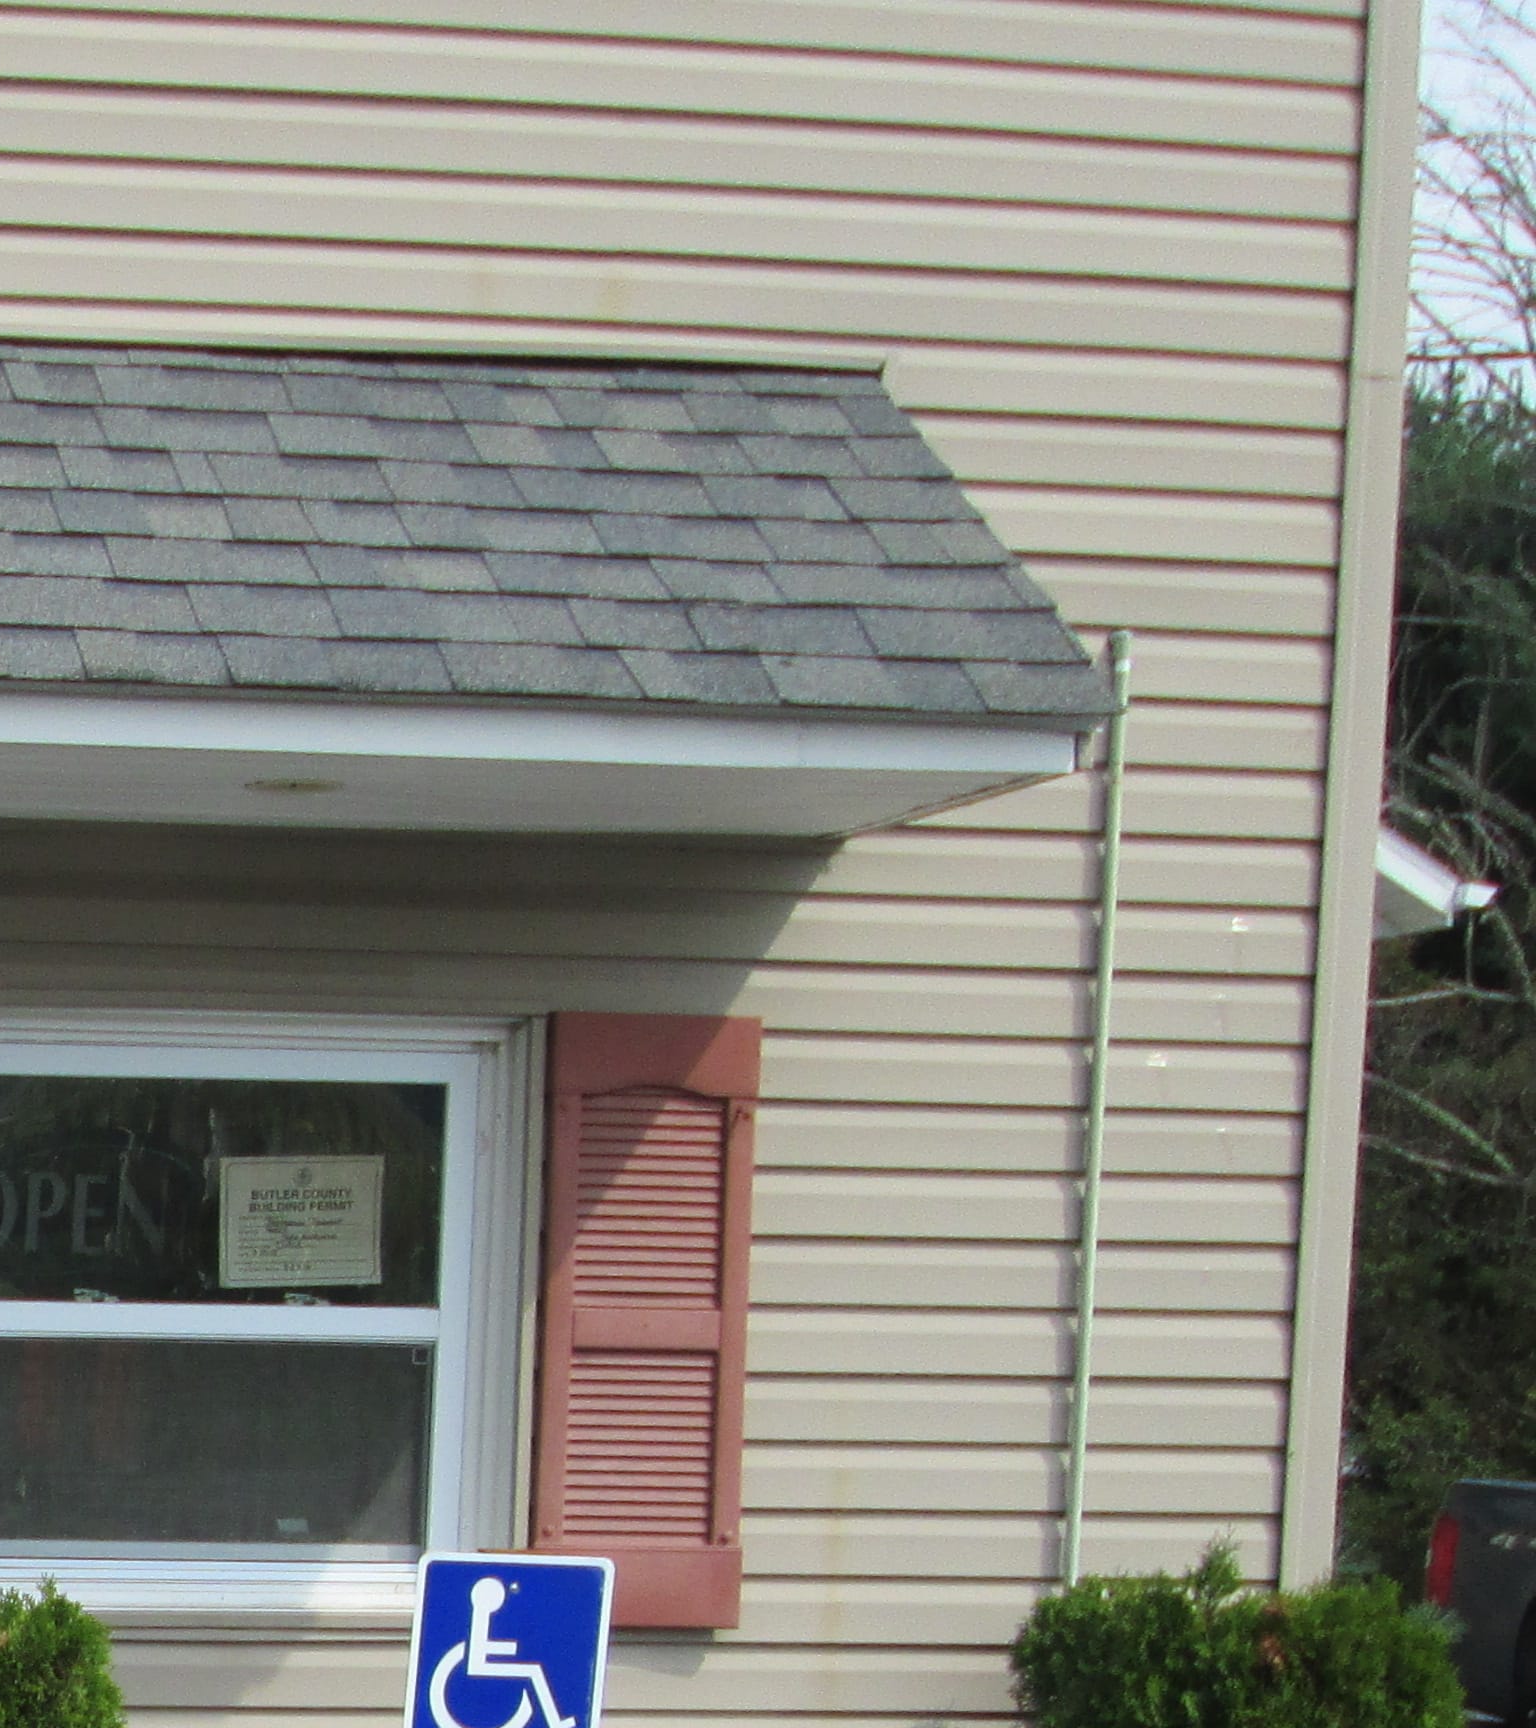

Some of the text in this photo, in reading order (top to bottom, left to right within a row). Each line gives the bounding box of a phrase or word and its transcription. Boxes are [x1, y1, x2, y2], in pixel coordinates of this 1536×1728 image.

[251, 1188, 353, 1200] BUTLER COUNTY
[249, 1200, 355, 1212] BUILDING PERMIT
